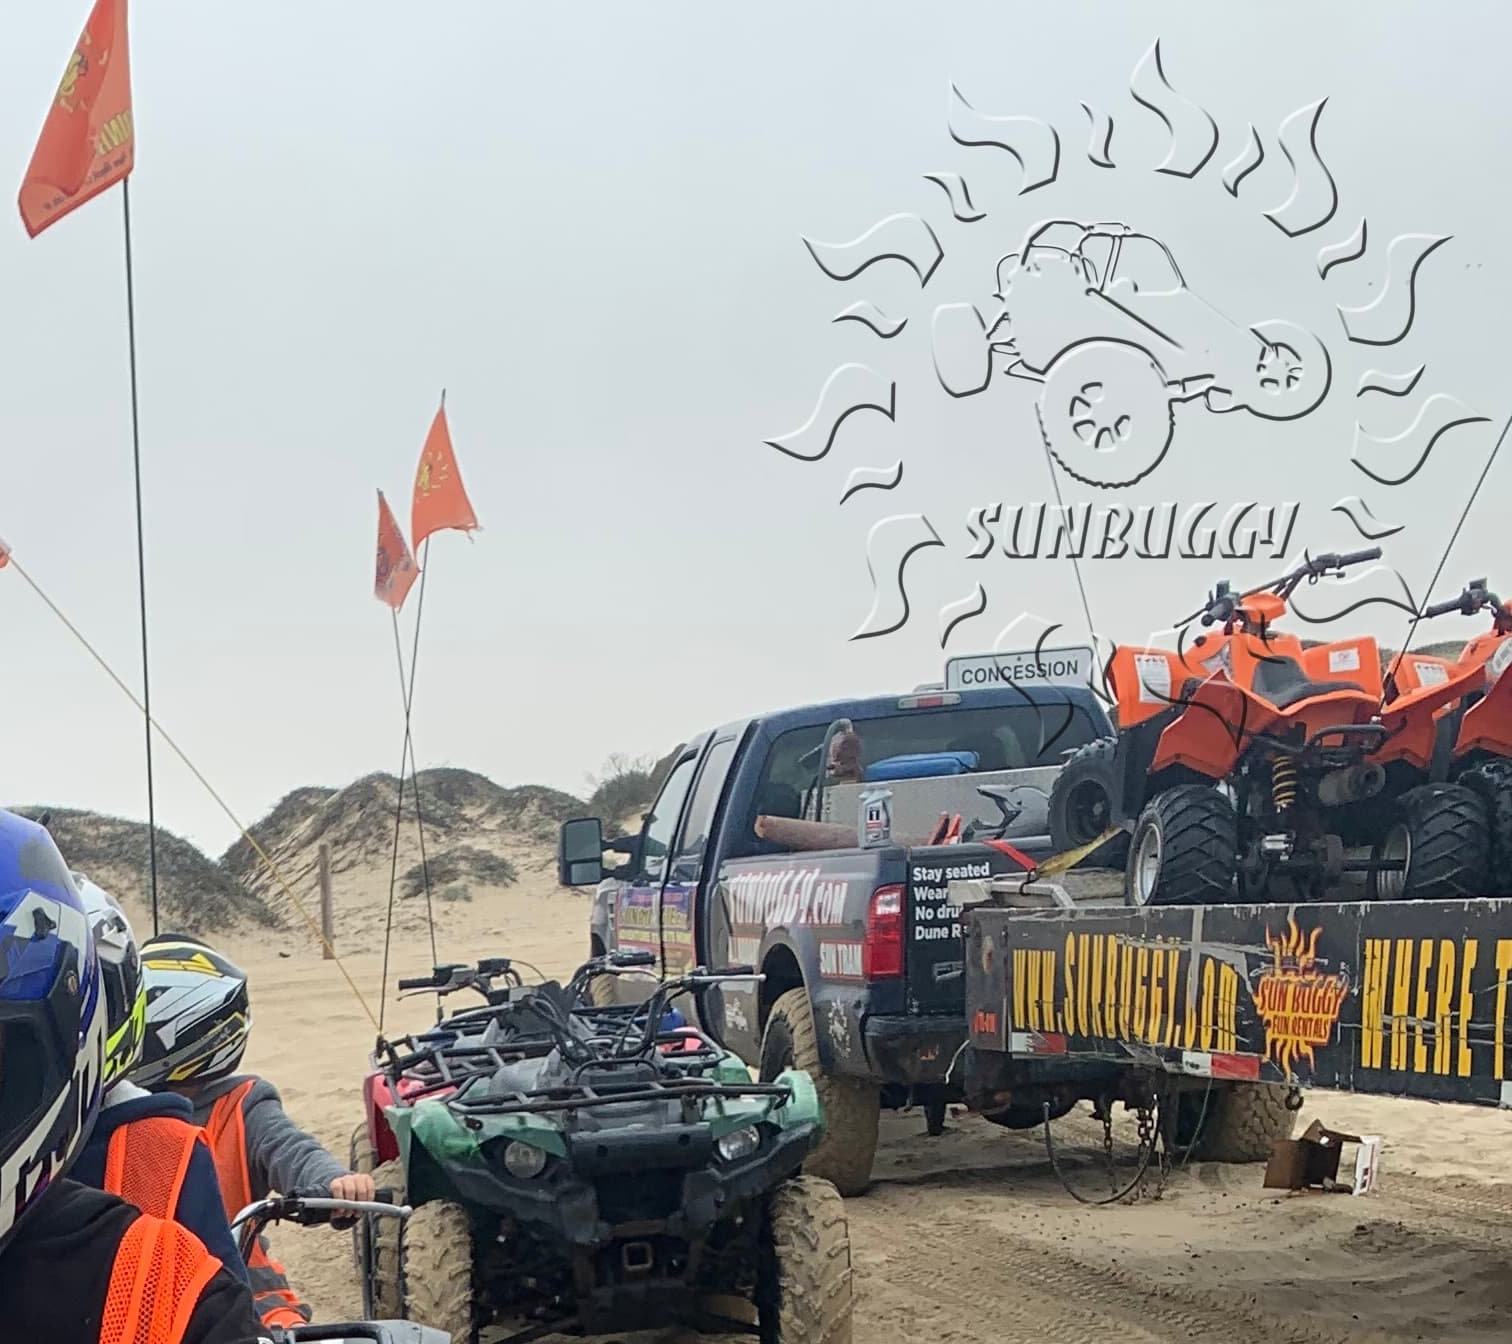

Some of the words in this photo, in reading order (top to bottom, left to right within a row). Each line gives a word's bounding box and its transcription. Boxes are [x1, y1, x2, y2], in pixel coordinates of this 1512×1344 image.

[961, 659, 1079, 685] CONCESSION
[913, 866, 943, 883] Stay
[945, 861, 990, 879] seated
[913, 886, 948, 902] Wear
[915, 906, 934, 921] No
[937, 903, 963, 919] dru
[915, 925, 949, 940] Dune
[1259, 980, 1288, 1012] SUN
[1292, 979, 1346, 1016] BUGGY
[1361, 938, 1478, 1077] WHERE
[1272, 1015, 1289, 1035] FUN
[1291, 1017, 1329, 1039] RENTALS
